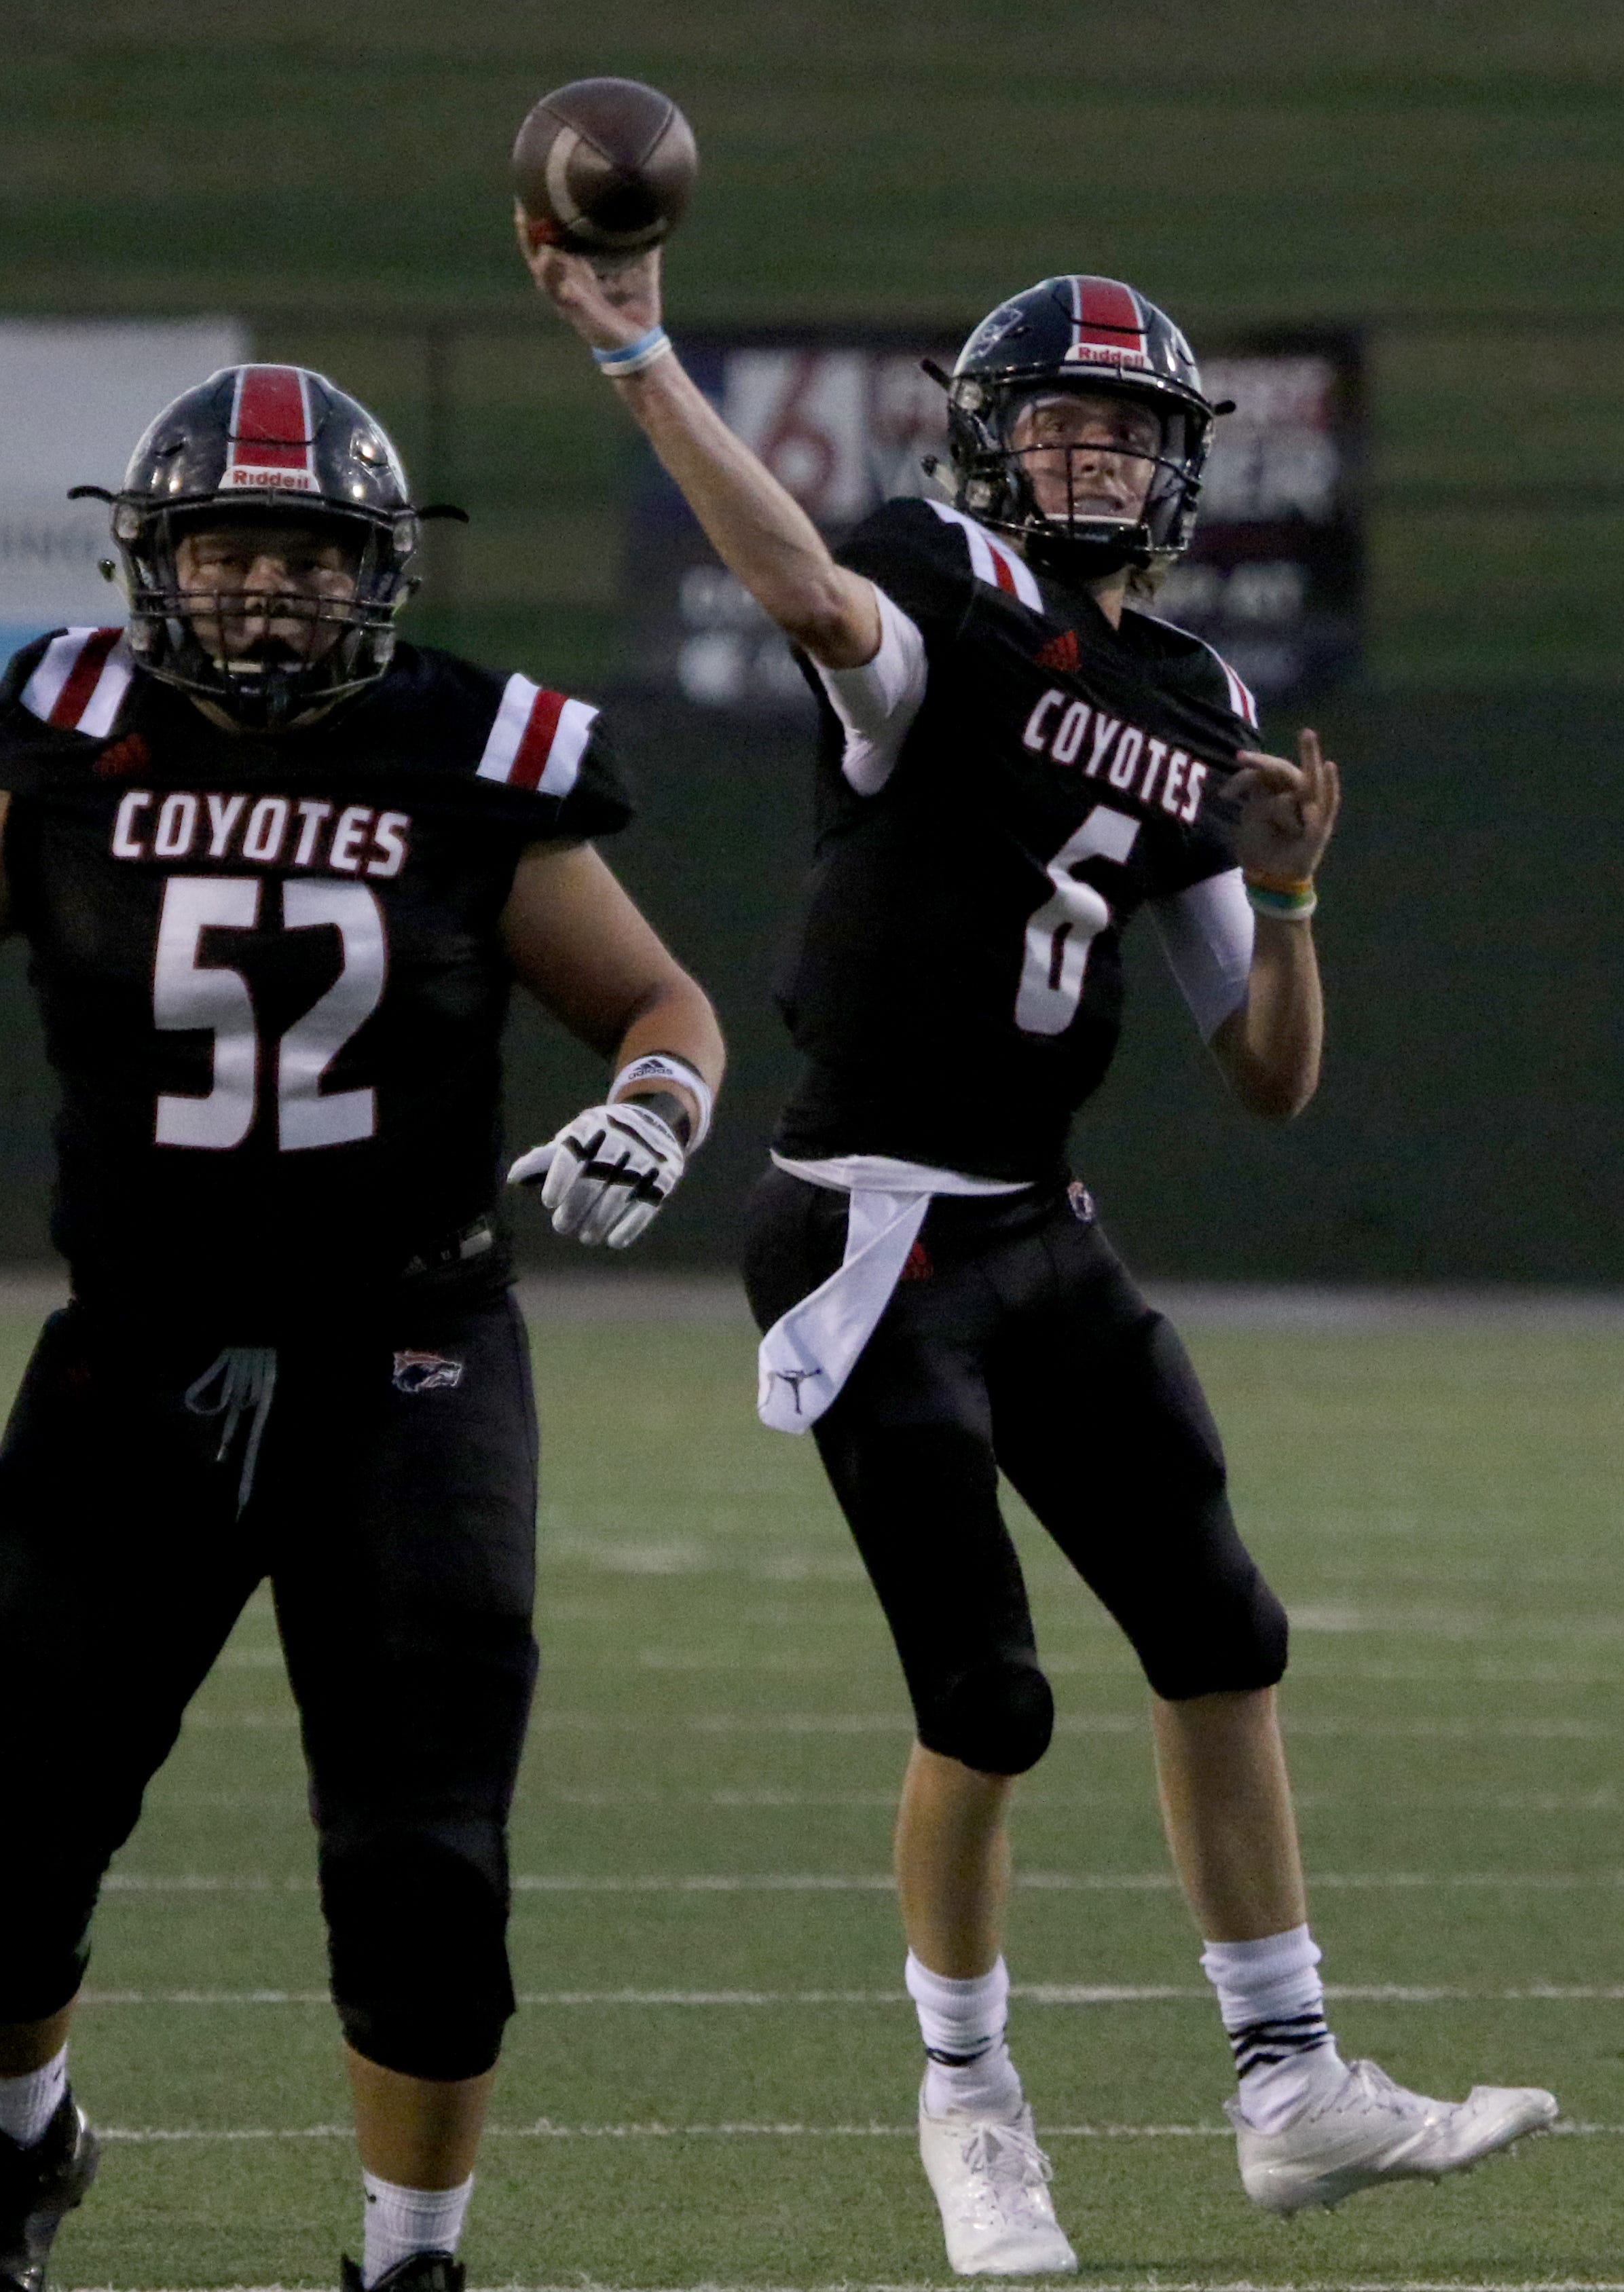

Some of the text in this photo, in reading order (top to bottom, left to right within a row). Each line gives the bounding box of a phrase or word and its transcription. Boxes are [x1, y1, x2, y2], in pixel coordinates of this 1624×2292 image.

[1077, 346, 1145, 369] Riddell
[233, 470, 310, 489] Riddell
[1022, 688, 1208, 824] COYOTES
[111, 790, 411, 878] COYOTES
[1014, 803, 1143, 1037] 6
[153, 876, 387, 1151] 52
[628, 1067, 673, 1079] adidas
